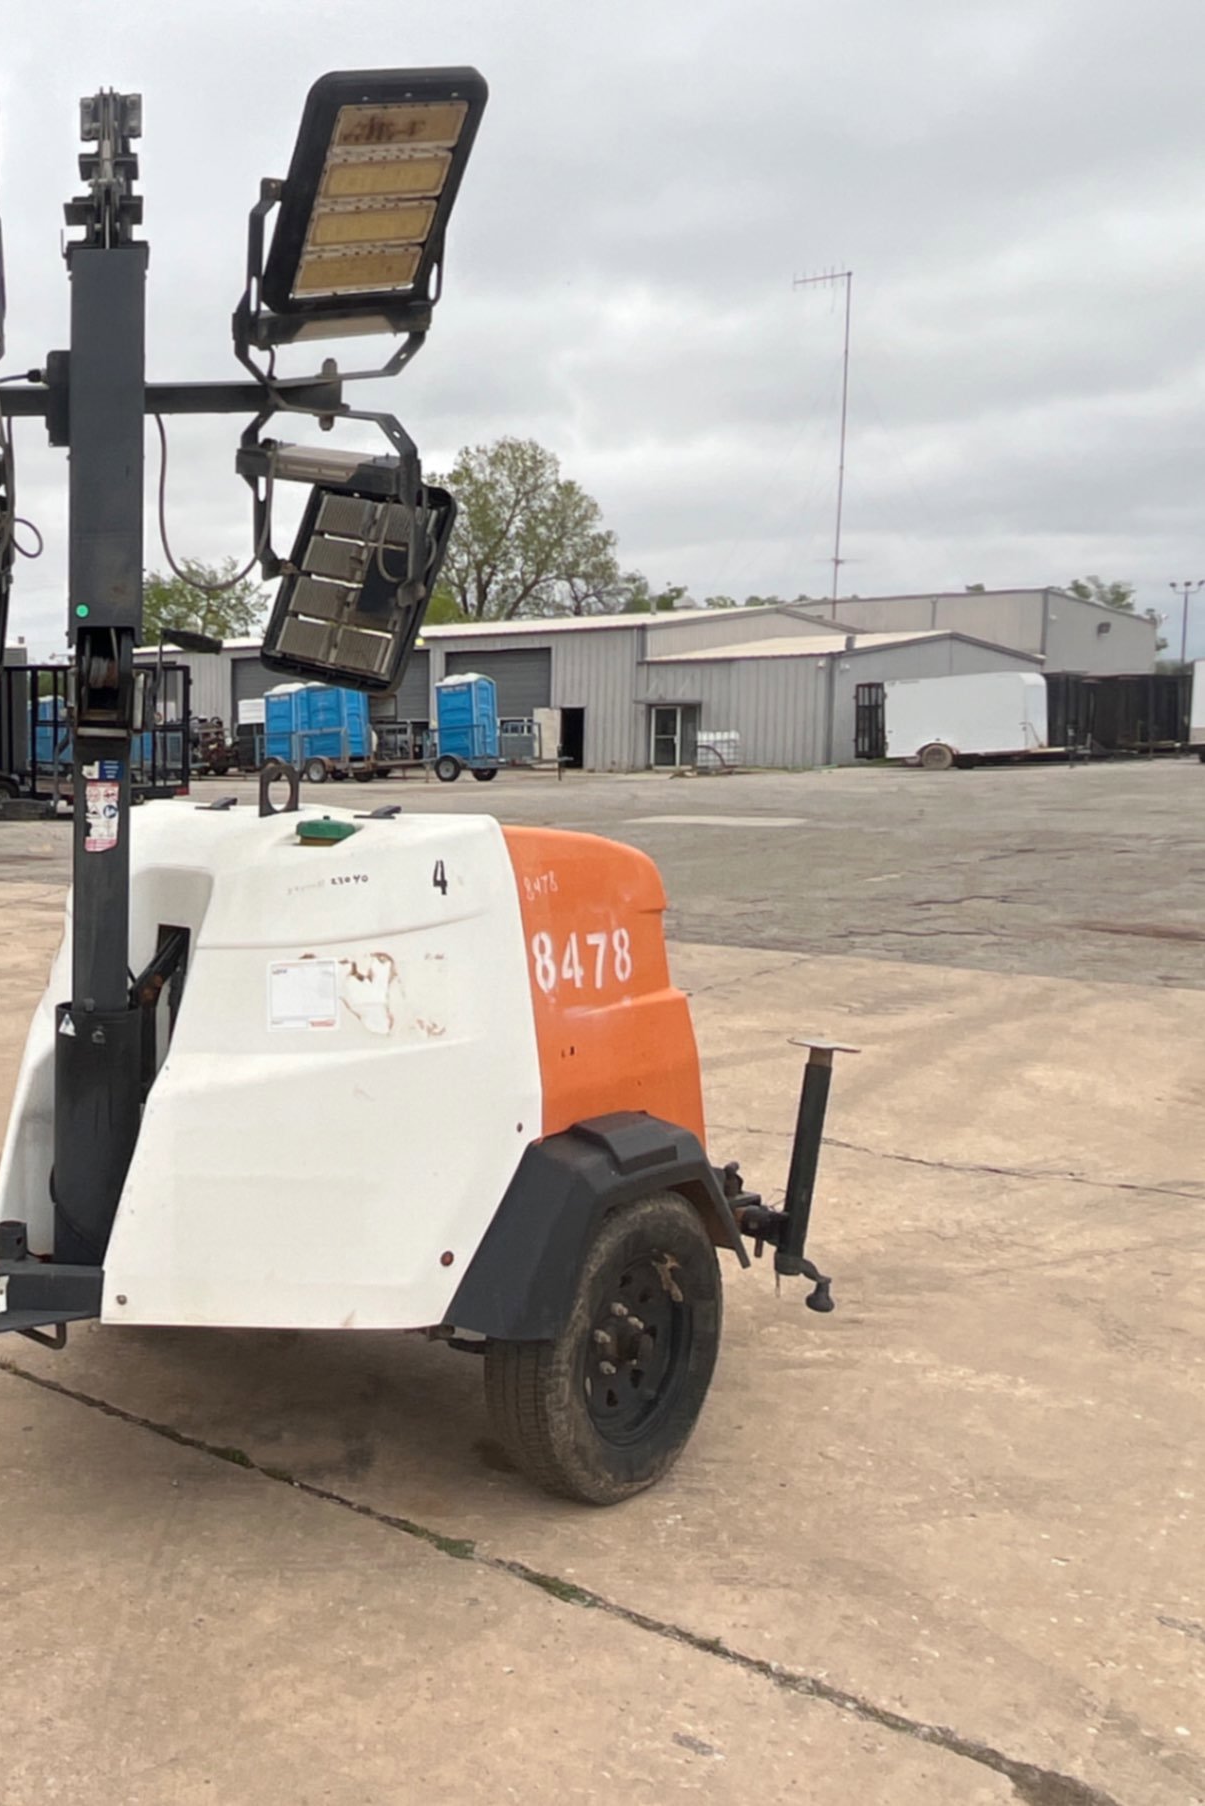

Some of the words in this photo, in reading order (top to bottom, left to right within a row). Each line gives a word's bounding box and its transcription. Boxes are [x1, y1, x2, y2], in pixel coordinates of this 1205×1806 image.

[432, 859, 448, 896] 4
[523, 869, 559, 901] 8478
[532, 928, 633, 993] 8478
